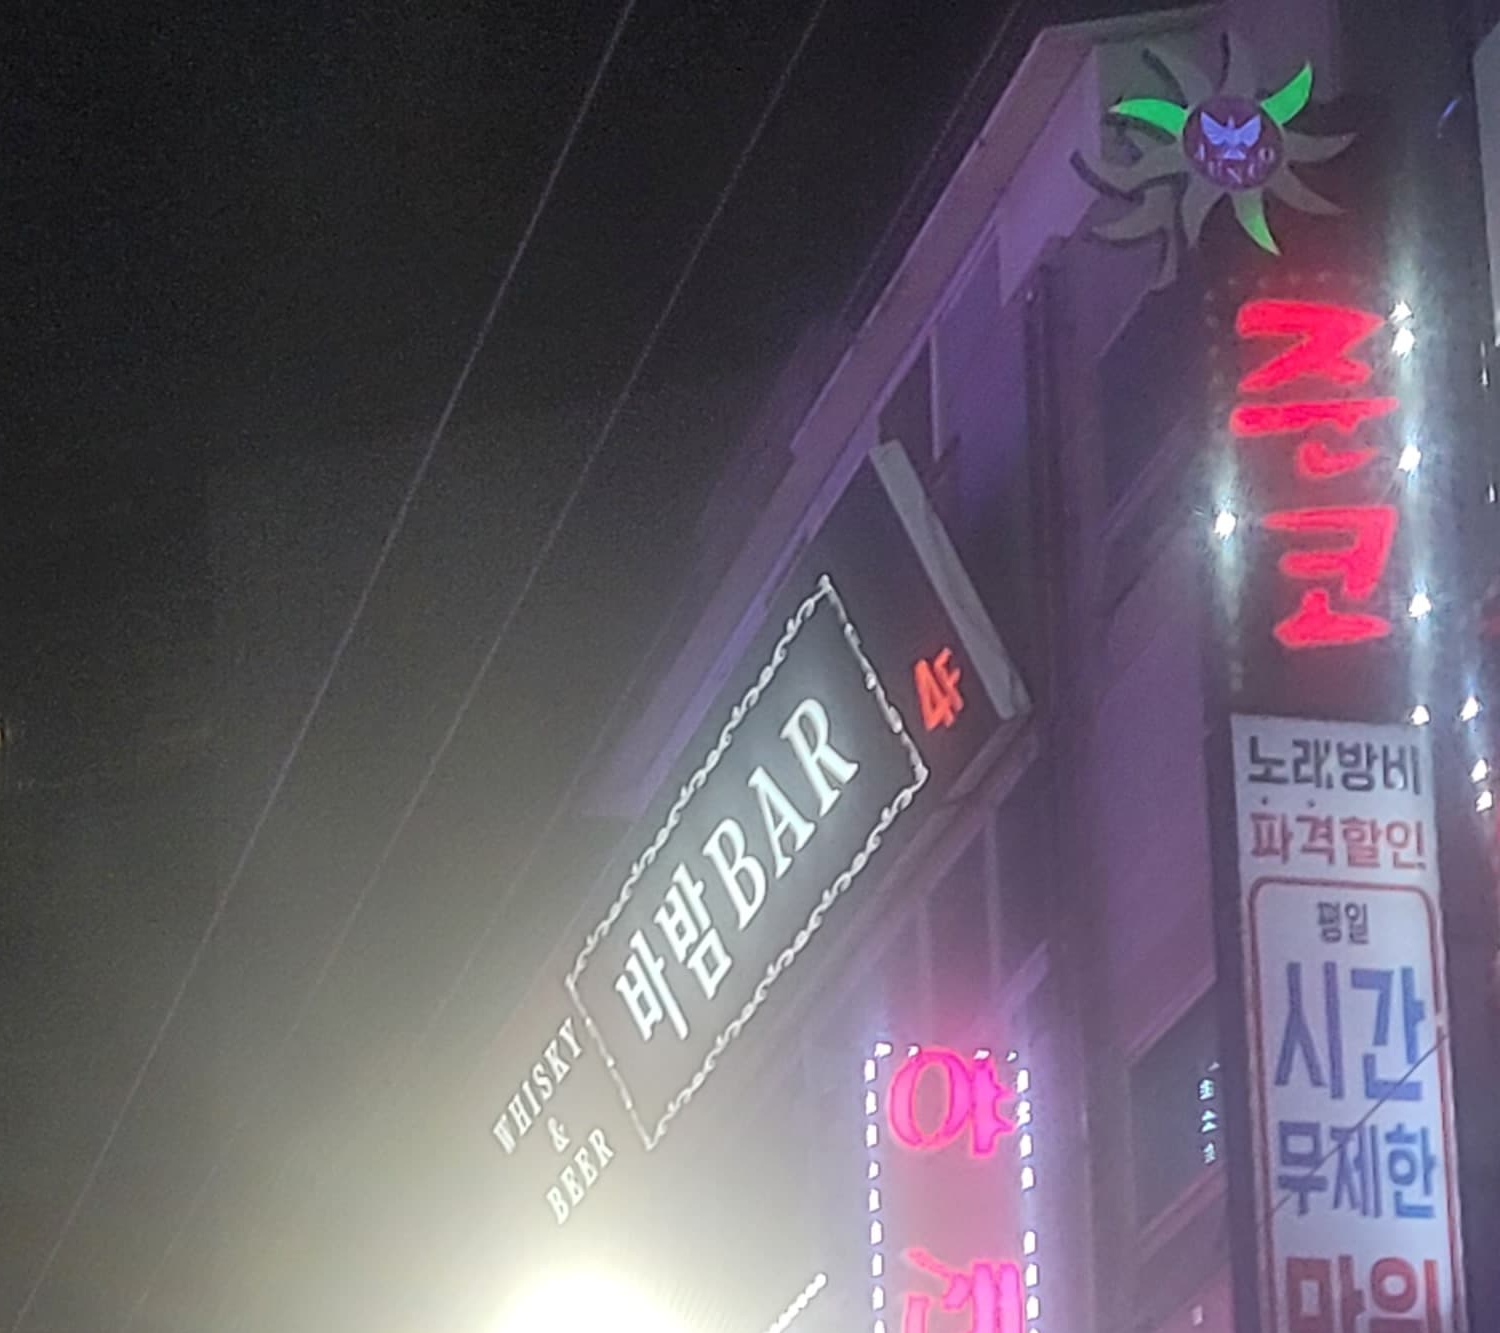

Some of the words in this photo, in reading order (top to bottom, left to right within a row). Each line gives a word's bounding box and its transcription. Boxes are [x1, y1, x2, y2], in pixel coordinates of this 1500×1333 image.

[911, 643, 966, 736] 4F
[702, 694, 862, 933] BAR
[1248, 733, 1424, 797] 노래방비
[1248, 812, 1430, 870] 파격할인
[1273, 960, 1428, 1102] 시간
[491, 1015, 587, 1157] WHISKY
[542, 1125, 617, 1227] BEER
[1277, 1119, 1438, 1220] 무제한
